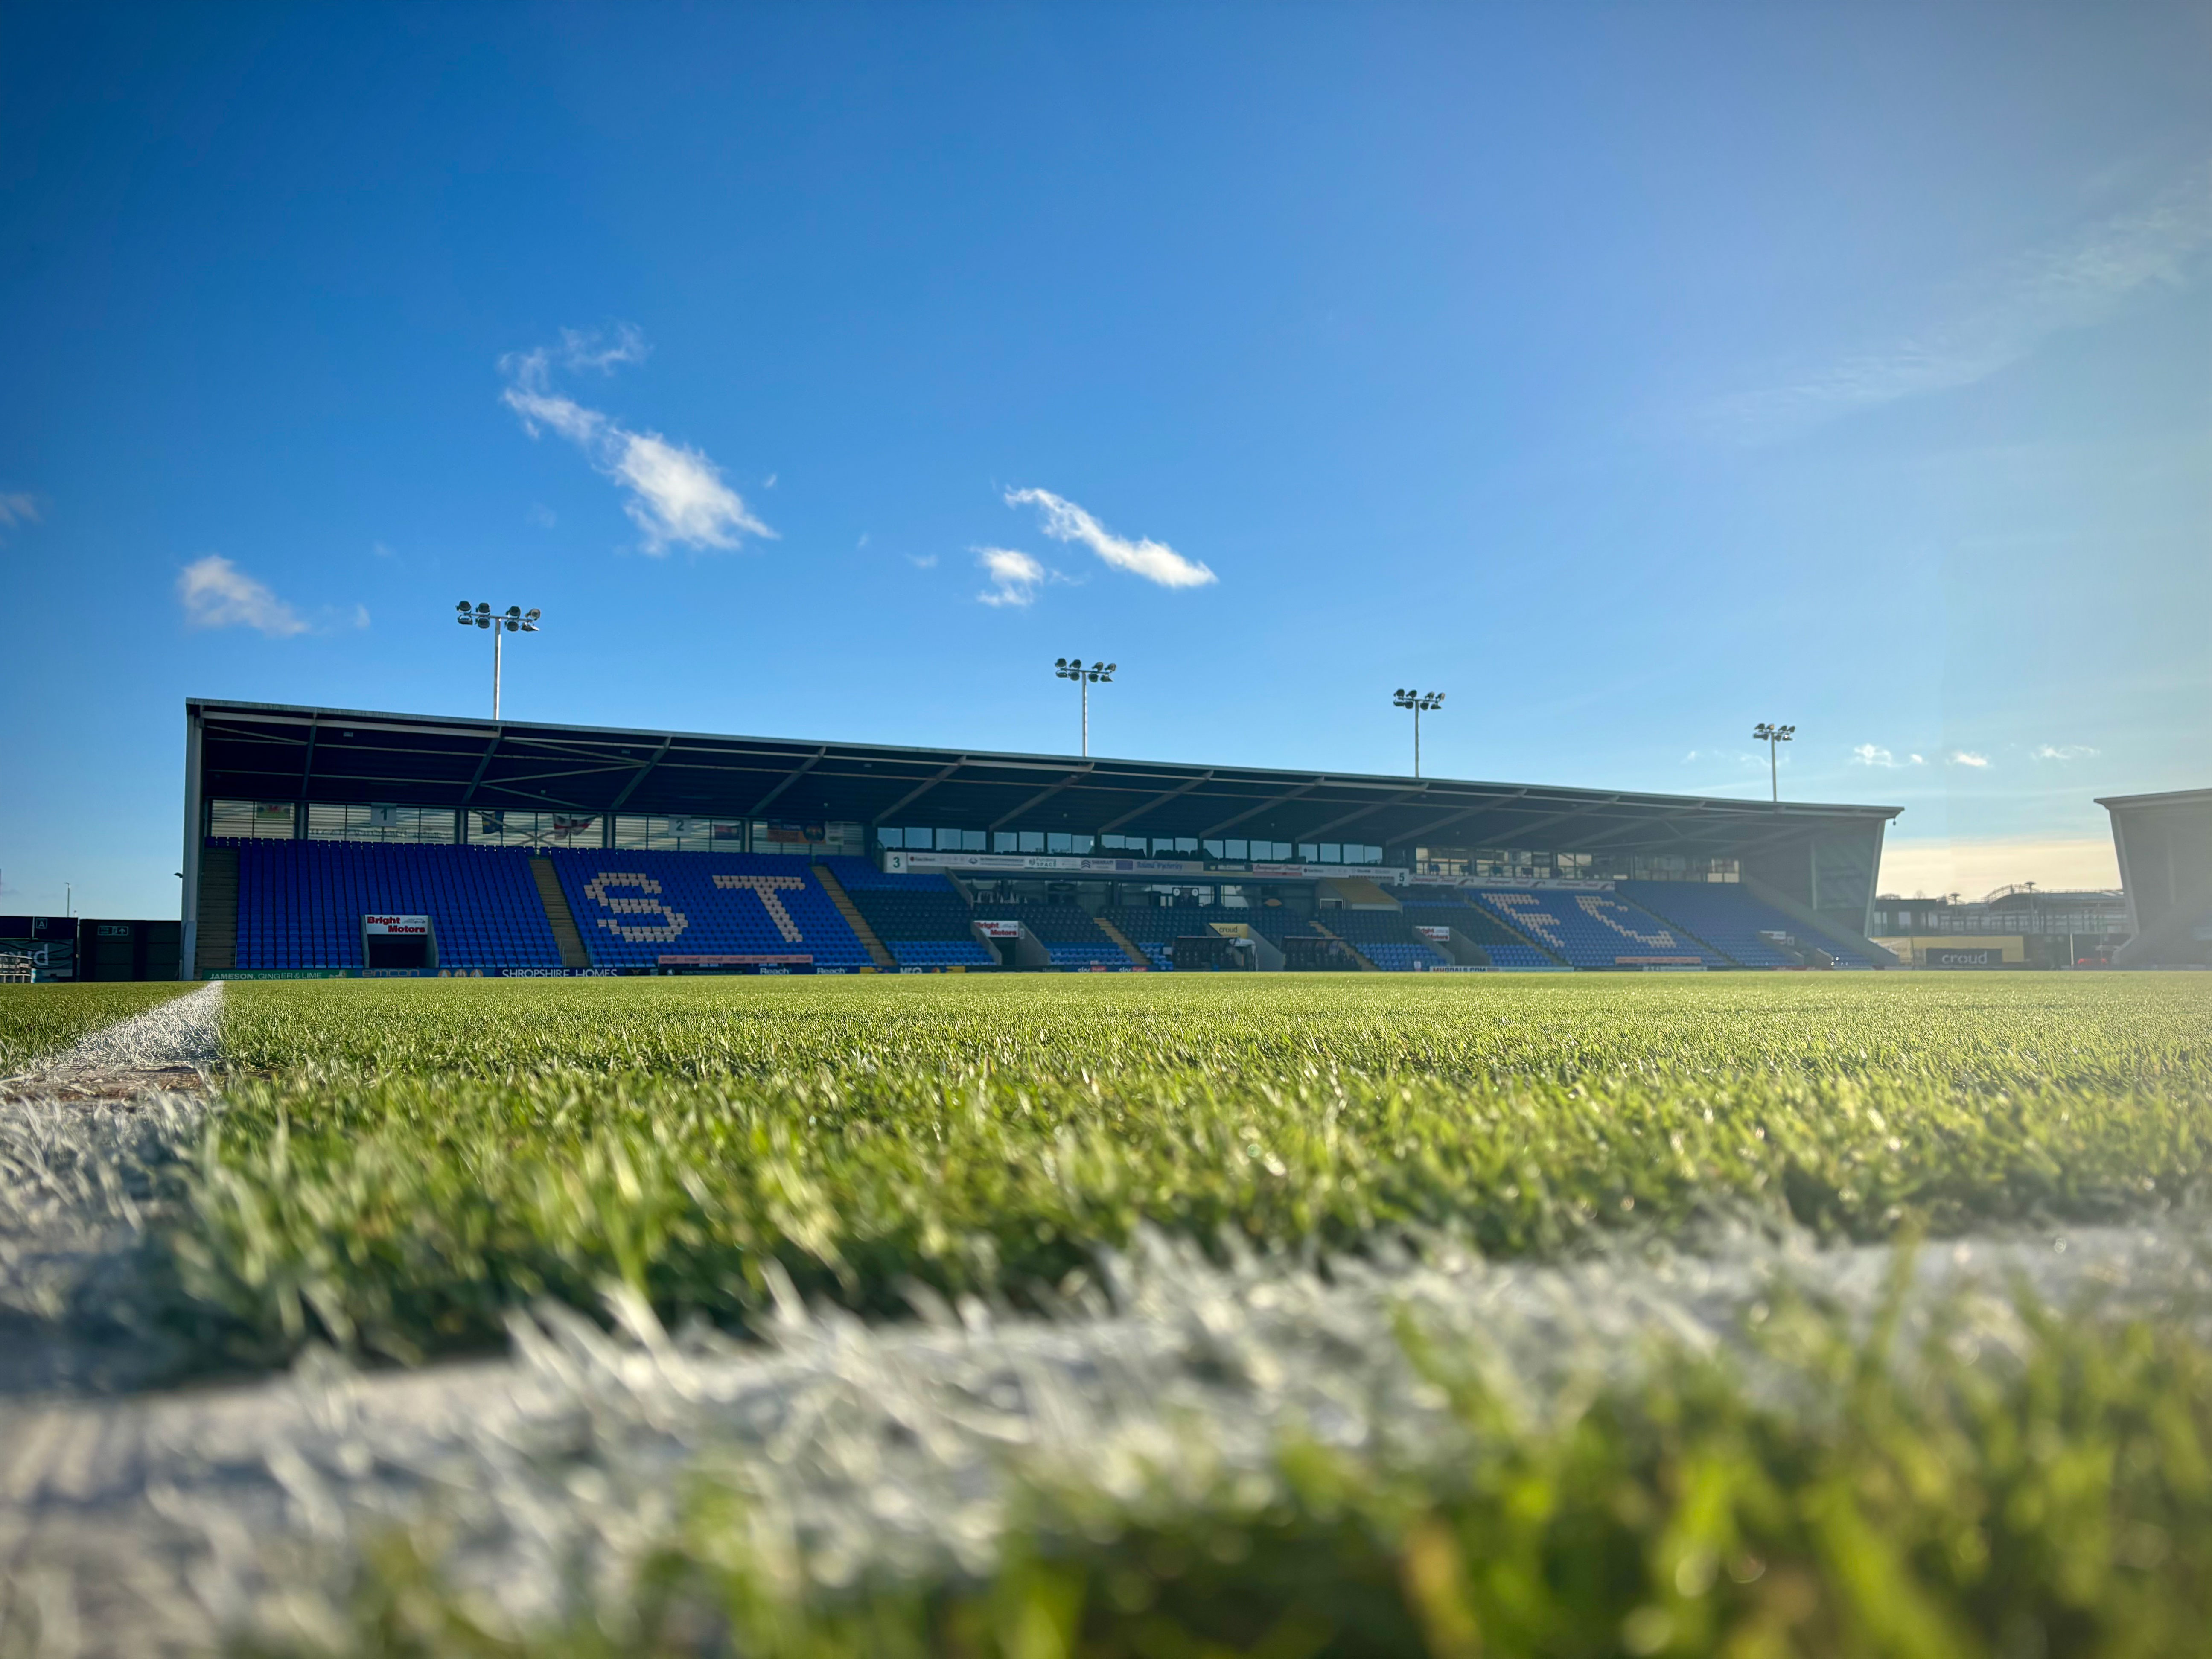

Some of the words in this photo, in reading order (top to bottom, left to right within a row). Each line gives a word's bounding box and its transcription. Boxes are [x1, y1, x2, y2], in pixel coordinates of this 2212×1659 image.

[676, 820, 684, 831] 2
[893, 857, 900, 868] 3
[1399, 872, 1405, 881] 5
[584, 872, 688, 942] S
[712, 875, 806, 942] T
[367, 916, 400, 925] Bright
[1942, 951, 1987, 964] croud
[502, 969, 570, 977] SHROPSHIRE
